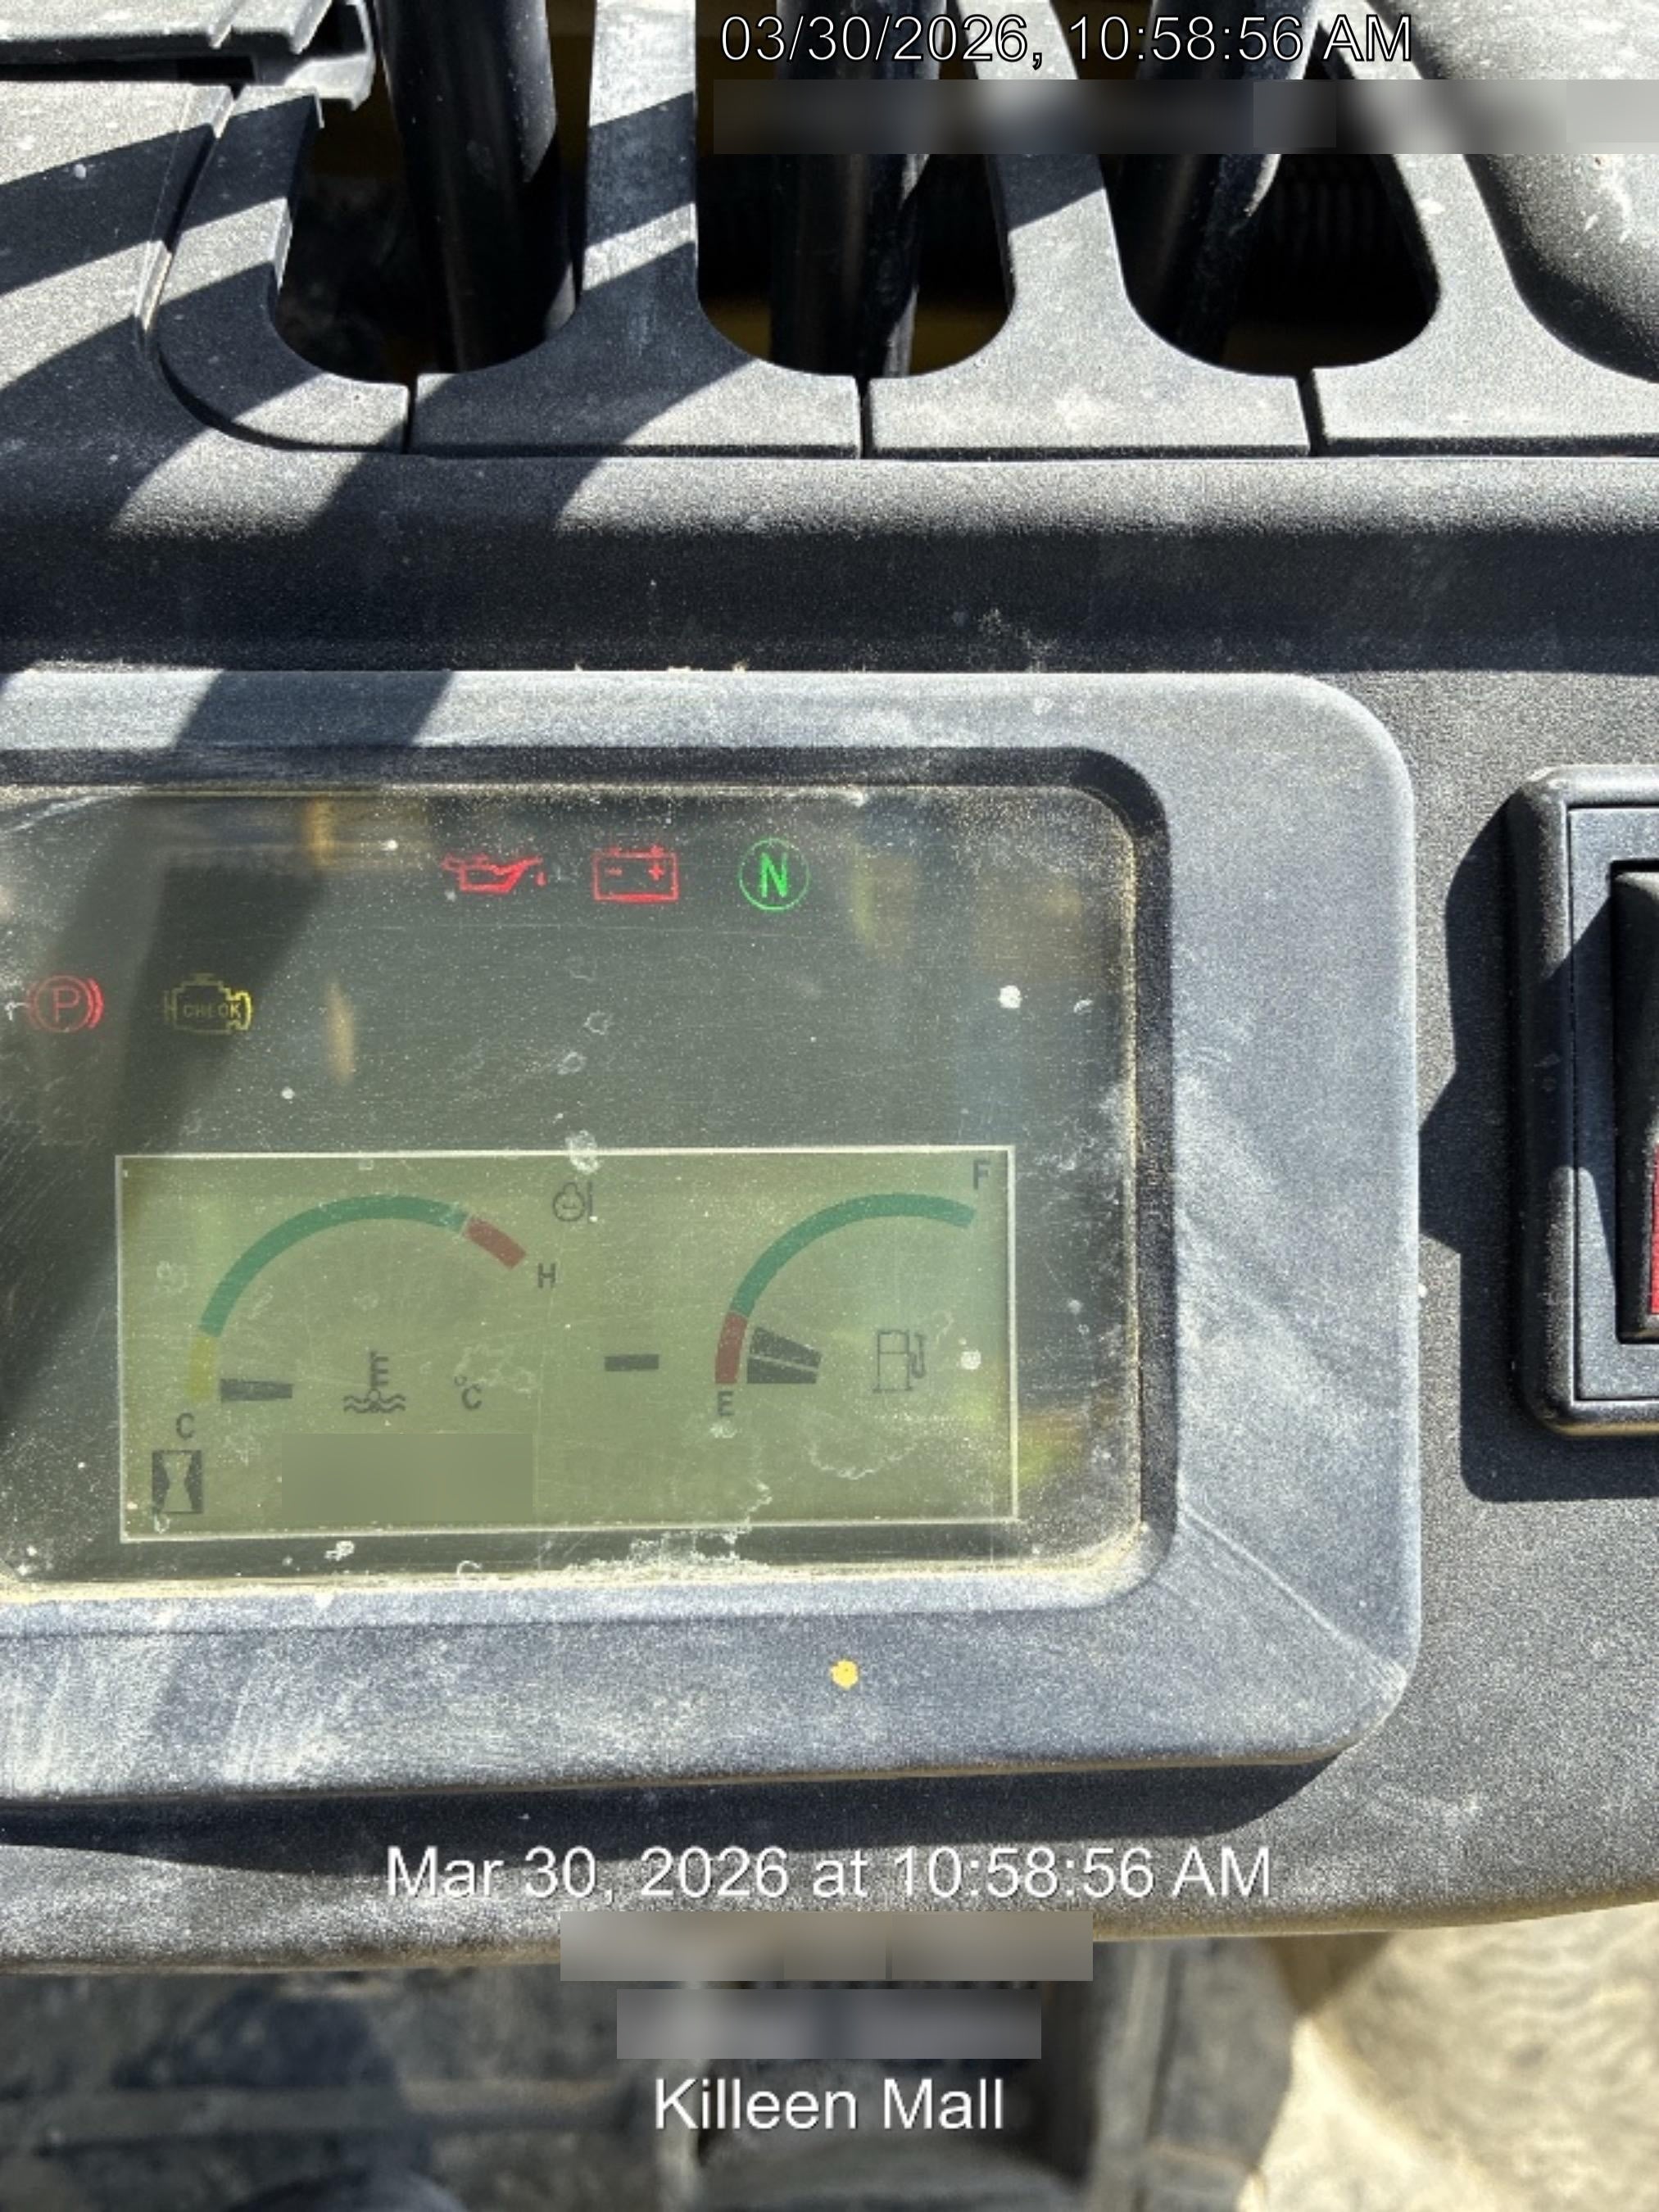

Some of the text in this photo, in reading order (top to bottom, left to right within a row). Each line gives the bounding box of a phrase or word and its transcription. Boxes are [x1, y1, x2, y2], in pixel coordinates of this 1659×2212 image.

[759, 852, 788, 898] N
[52, 986, 79, 1024] P
[972, 1158, 990, 1190] F
[537, 1262, 556, 1289] H
[717, 1390, 735, 1416] E
[175, 1412, 195, 1440] C
